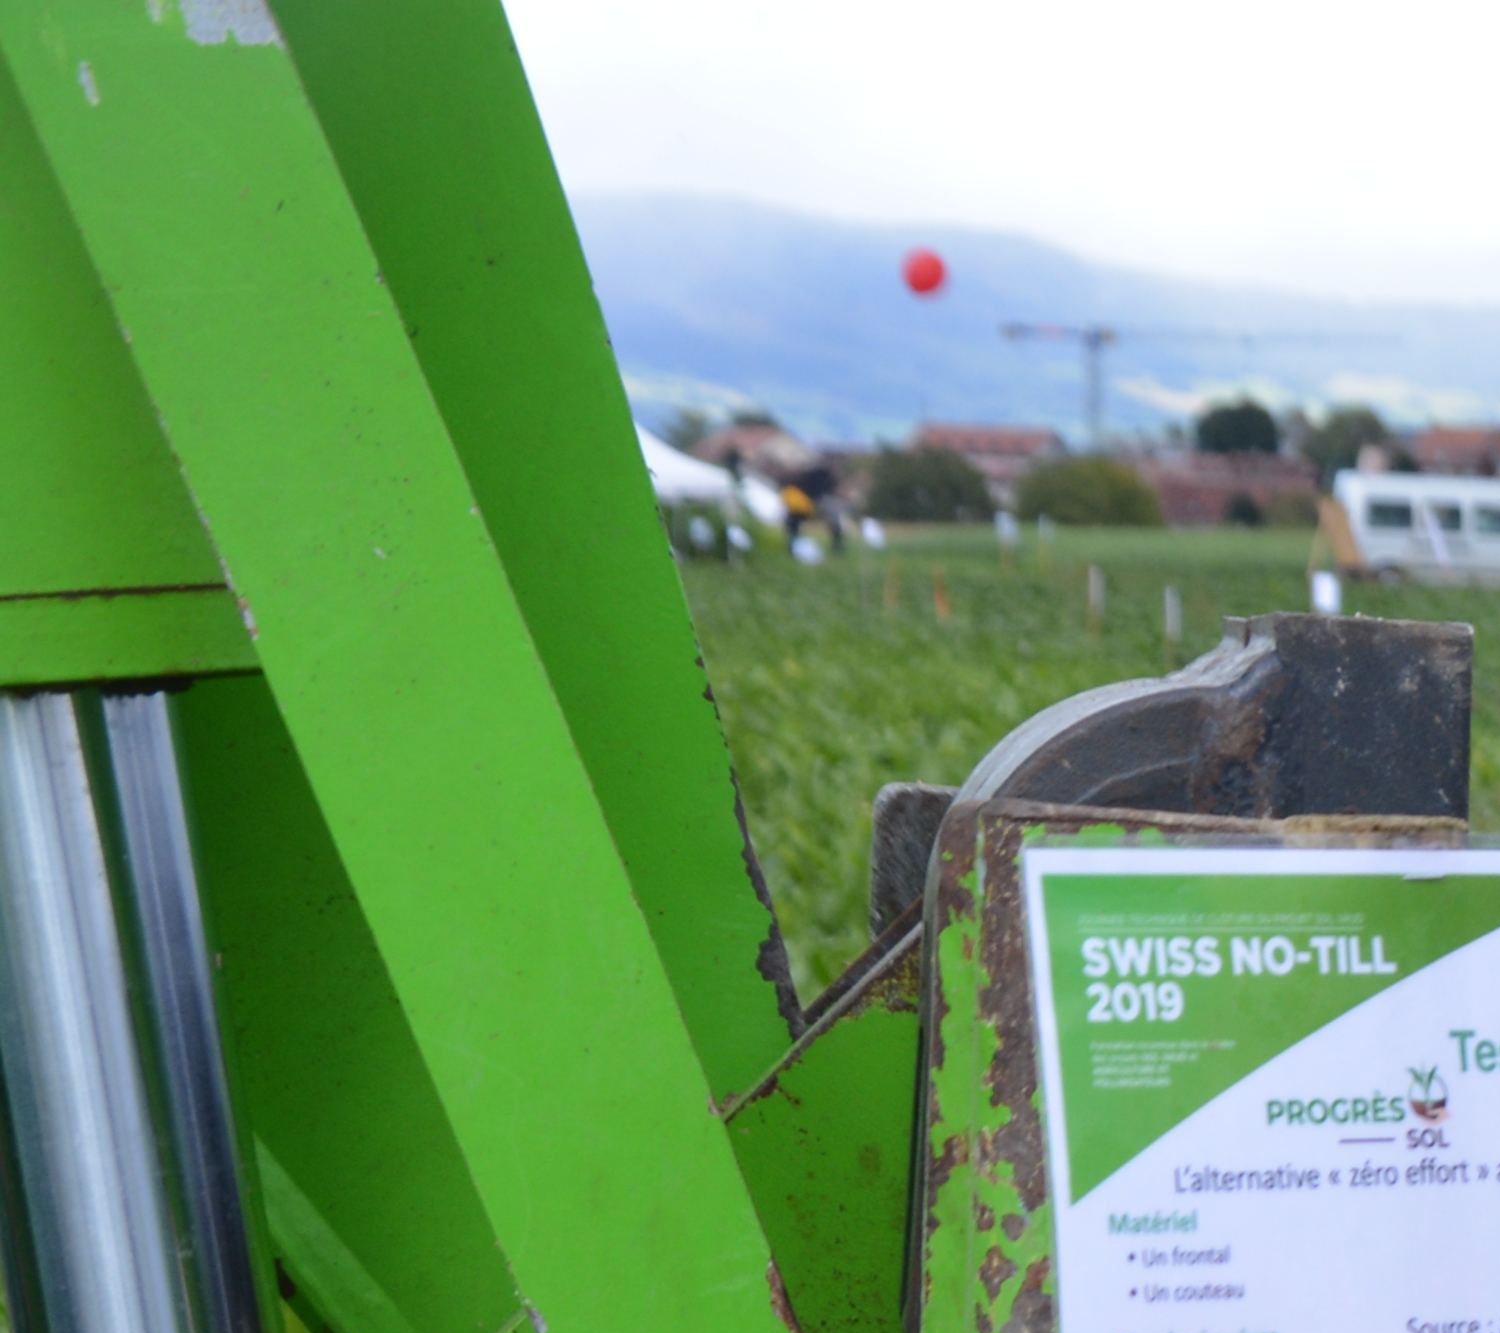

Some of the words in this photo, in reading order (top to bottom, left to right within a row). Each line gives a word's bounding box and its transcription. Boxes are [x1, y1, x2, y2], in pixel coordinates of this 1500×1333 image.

[1082, 936, 1222, 976] SWISS
[1231, 935, 1397, 975] NO-TILL
[1086, 981, 1184, 1022] 2019
[1267, 1090, 1404, 1126] PROGRÈS
[1406, 1128, 1449, 1149] SOL
[1174, 1164, 1321, 1193] L'alternative
[1328, 1169, 1341, 1185] «
[1349, 1161, 1398, 1187] zéro
[1405, 1157, 1469, 1186] effort
[1477, 1164, 1489, 1180] »
[1108, 1210, 1197, 1235] Matériel
[1142, 1249, 1166, 1268] Un
[1172, 1245, 1230, 1266] frontal
[1144, 1285, 1168, 1303] Un
[1174, 1284, 1244, 1302] couteau
